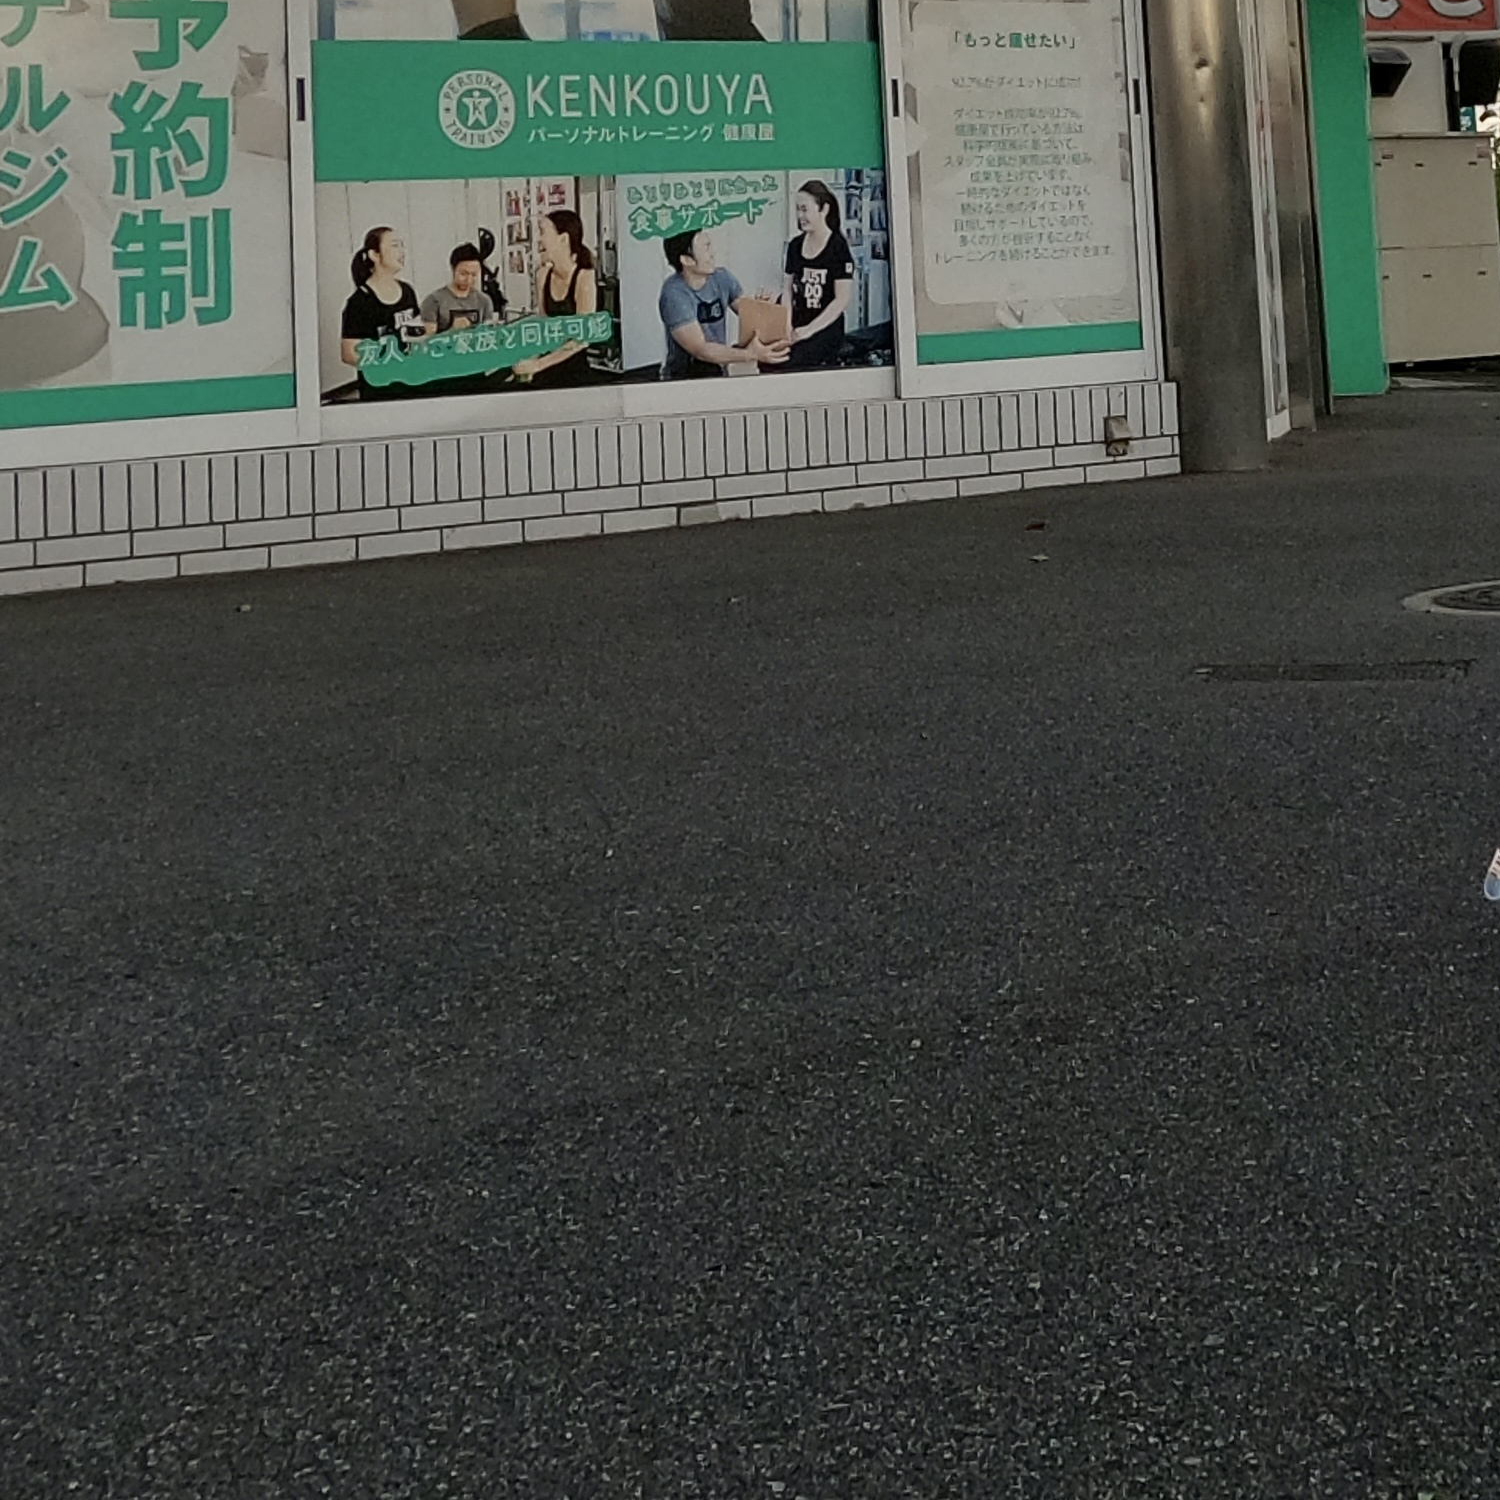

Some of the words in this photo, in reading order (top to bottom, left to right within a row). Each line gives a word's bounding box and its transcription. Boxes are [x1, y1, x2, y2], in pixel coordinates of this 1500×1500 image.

[443, 73, 510, 102] PERSONAL
[526, 73, 774, 119] KENKOUYA
[445, 119, 511, 145] TRAINING
[528, 122, 716, 144] パーソナルトレーニング
[800, 267, 829, 285] JUST
[804, 282, 823, 299] DO
